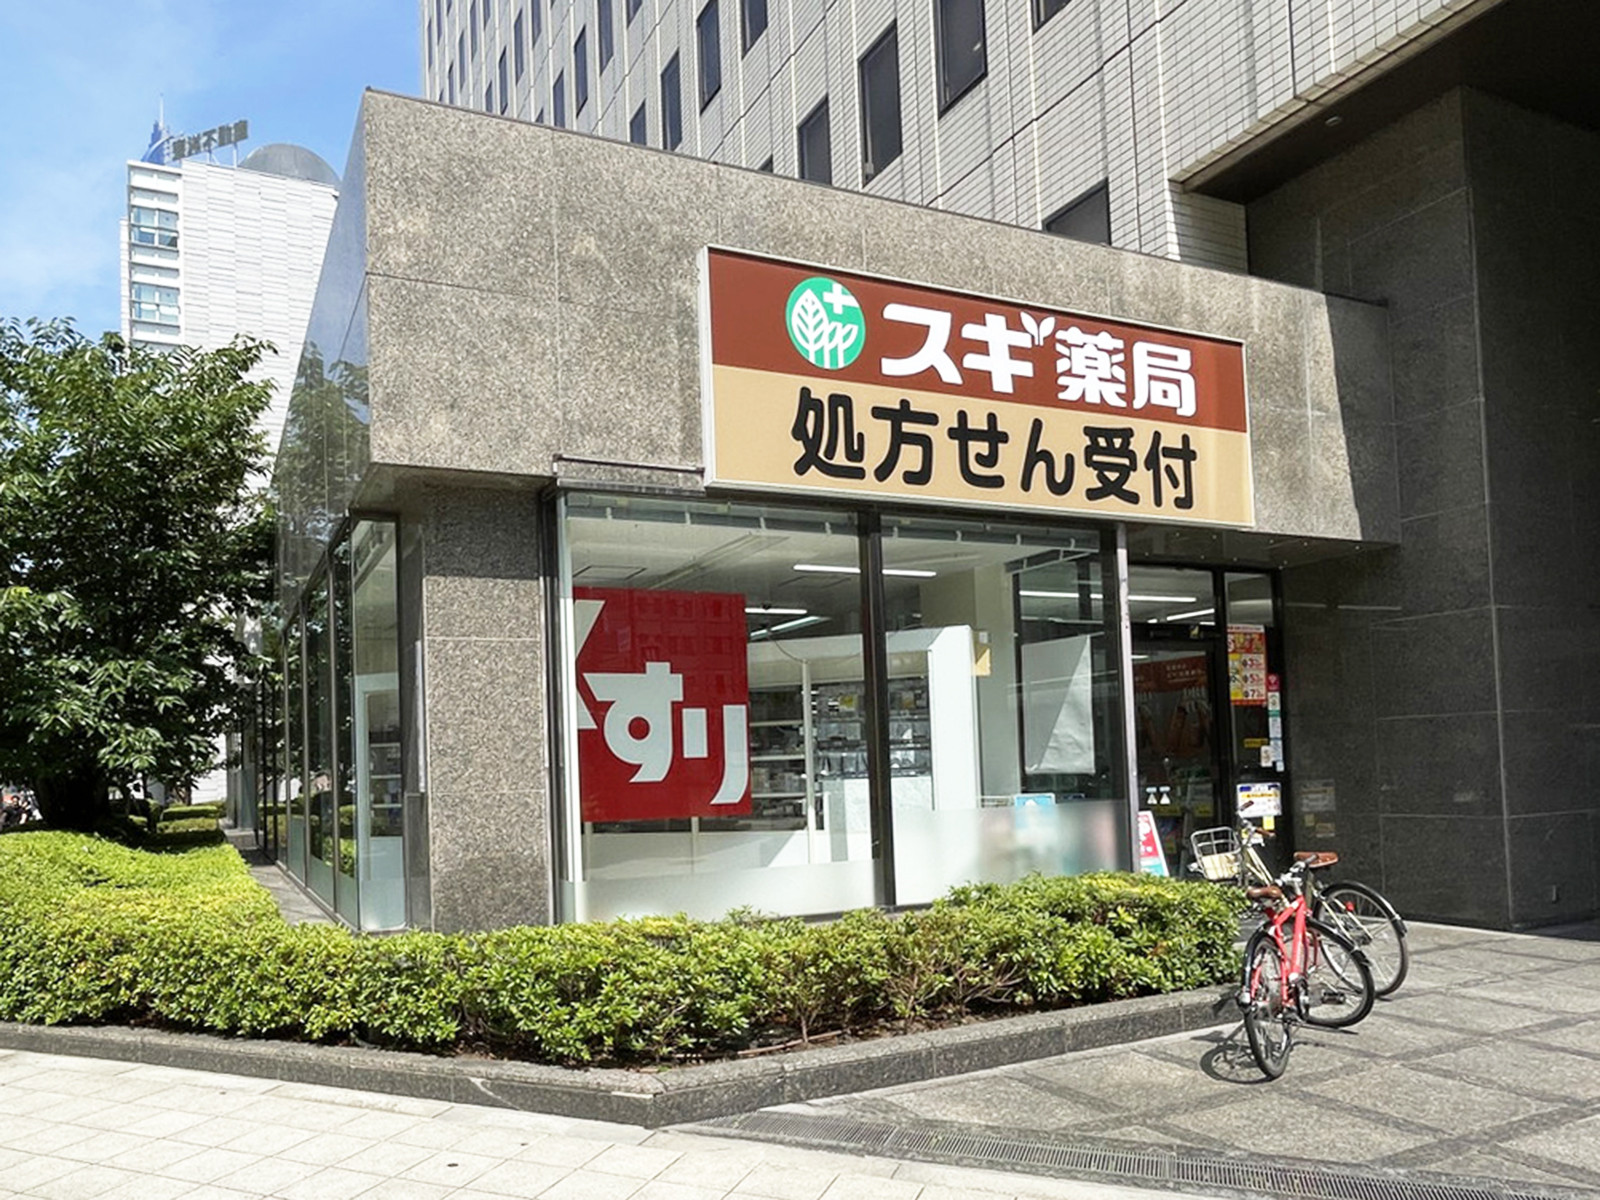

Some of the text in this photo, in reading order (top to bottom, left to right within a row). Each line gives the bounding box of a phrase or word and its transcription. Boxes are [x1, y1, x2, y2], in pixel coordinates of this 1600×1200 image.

[880, 302, 1197, 417] スギ薬局
[791, 387, 1197, 510] 処方せん受付
